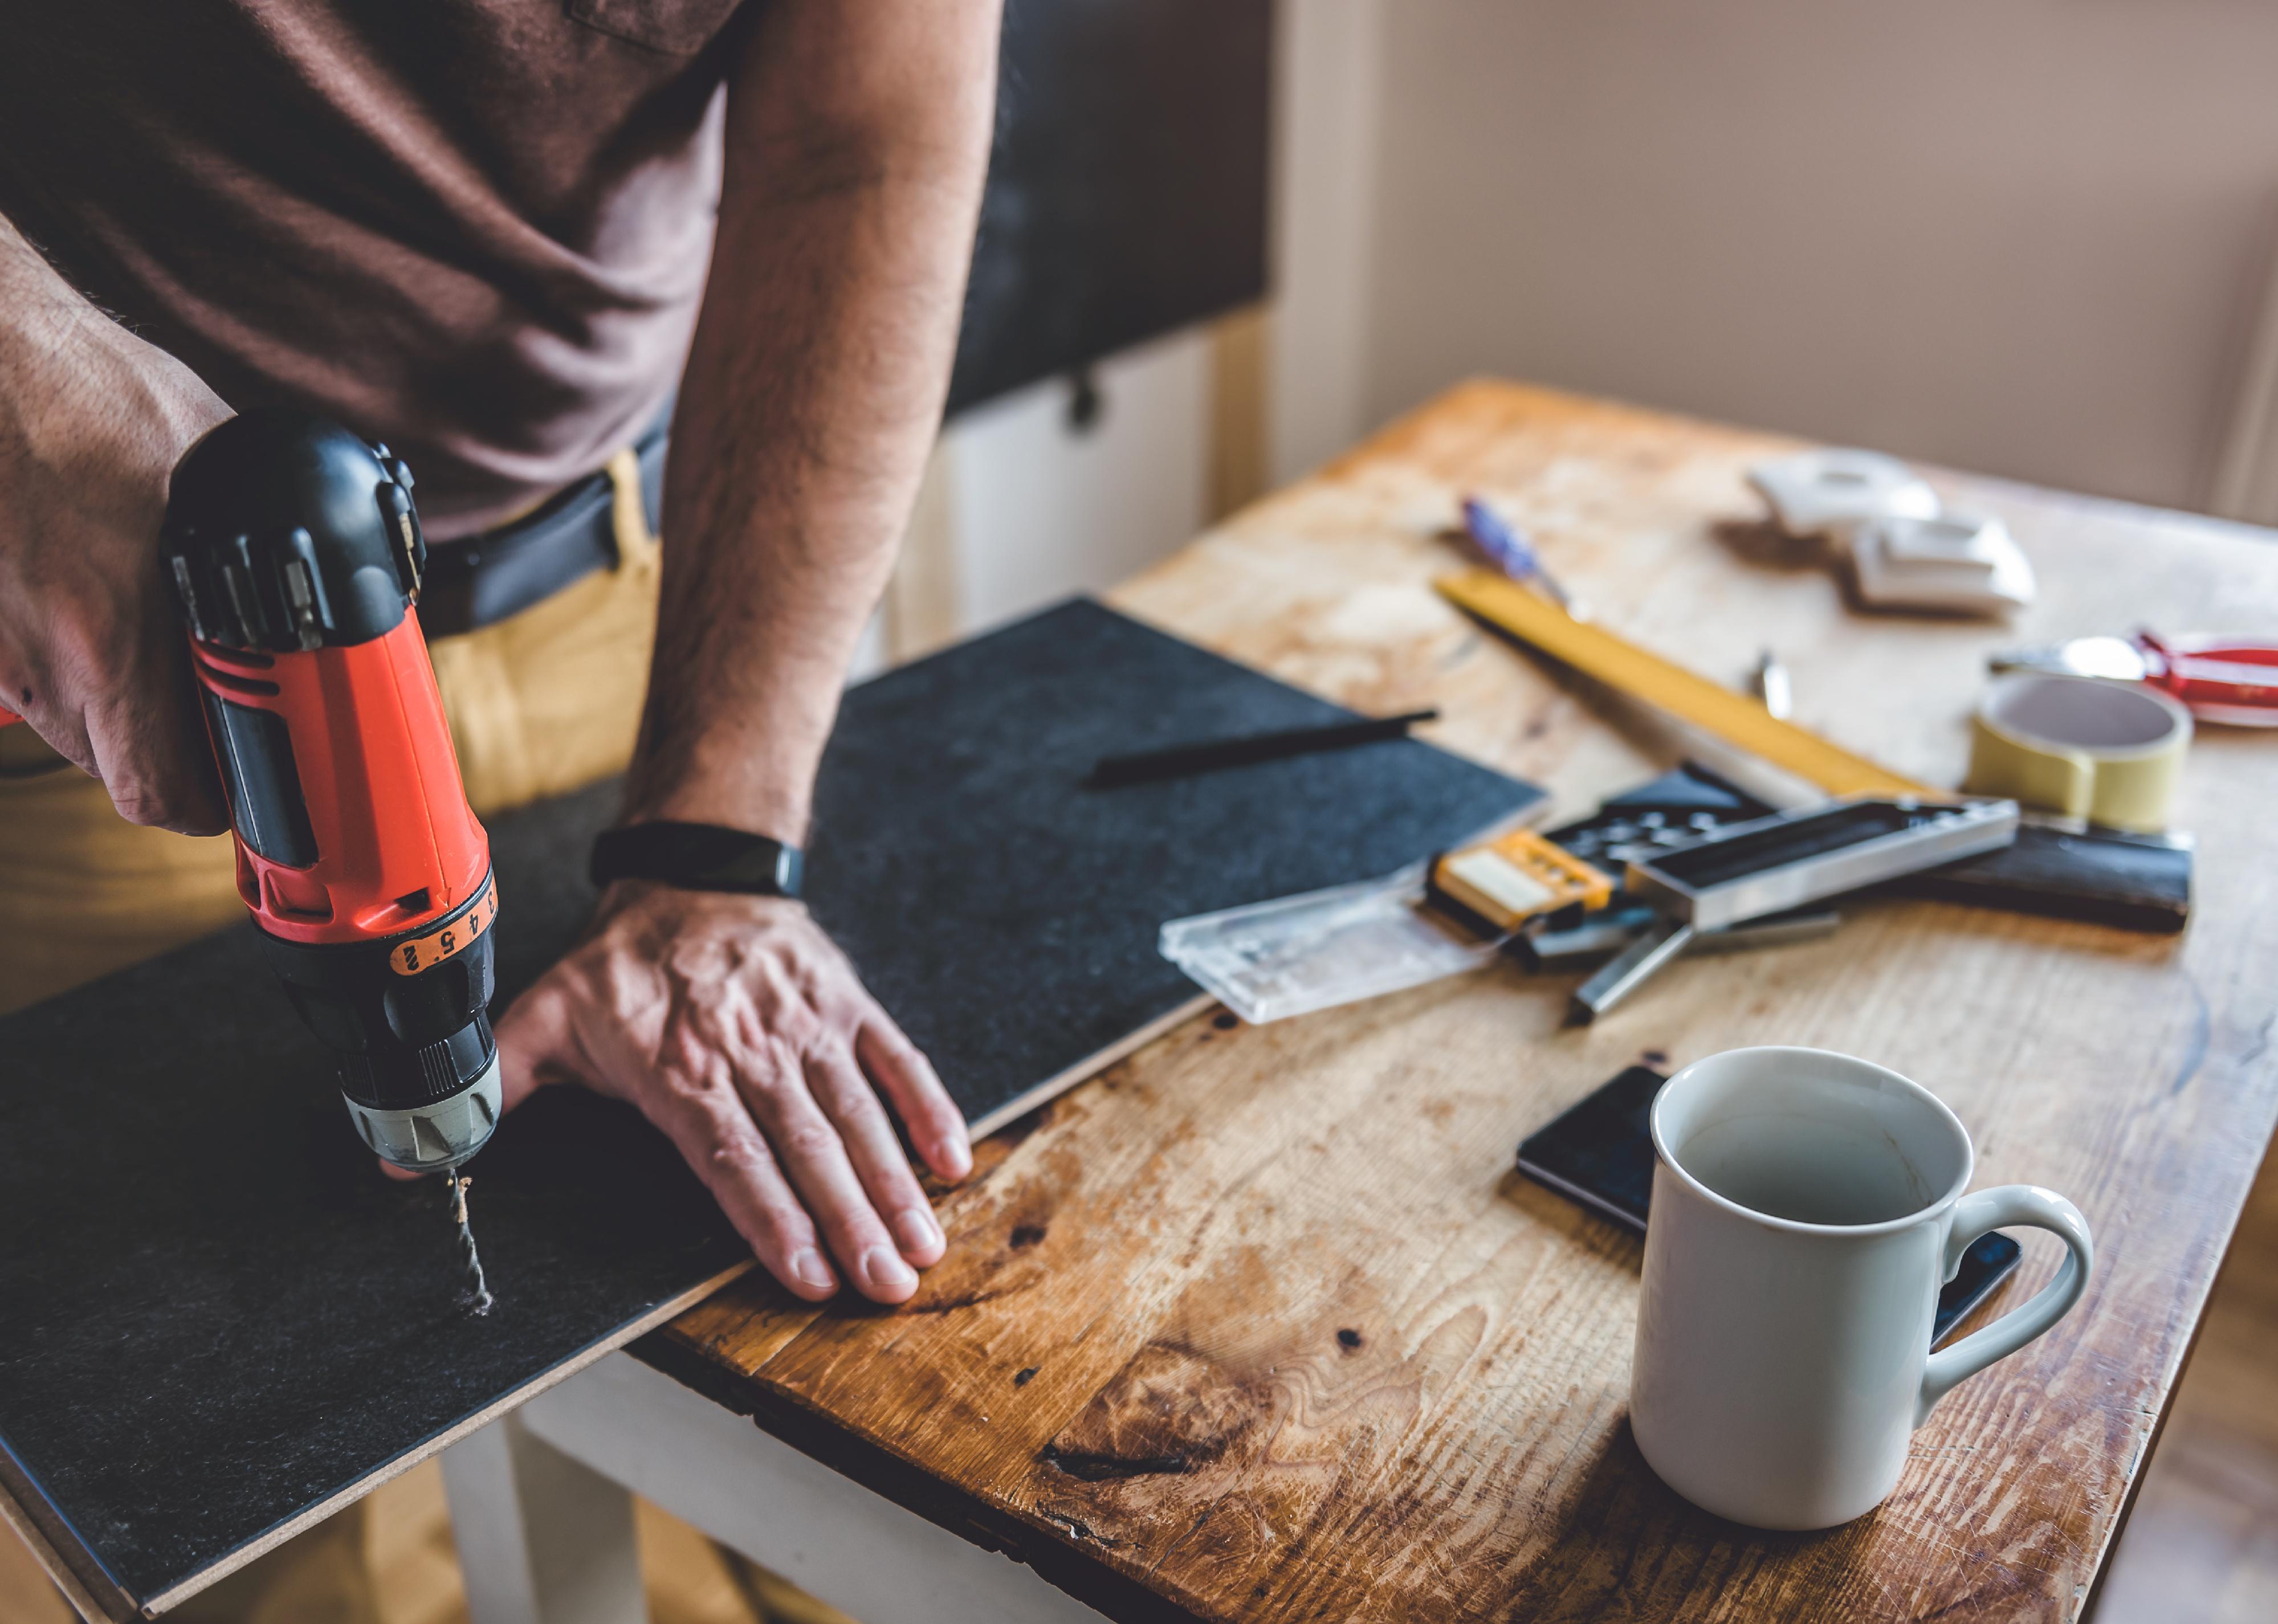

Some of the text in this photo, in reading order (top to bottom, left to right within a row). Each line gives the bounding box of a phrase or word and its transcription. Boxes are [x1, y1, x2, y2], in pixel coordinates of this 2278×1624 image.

[441, 891, 494, 955] 3 4 5
